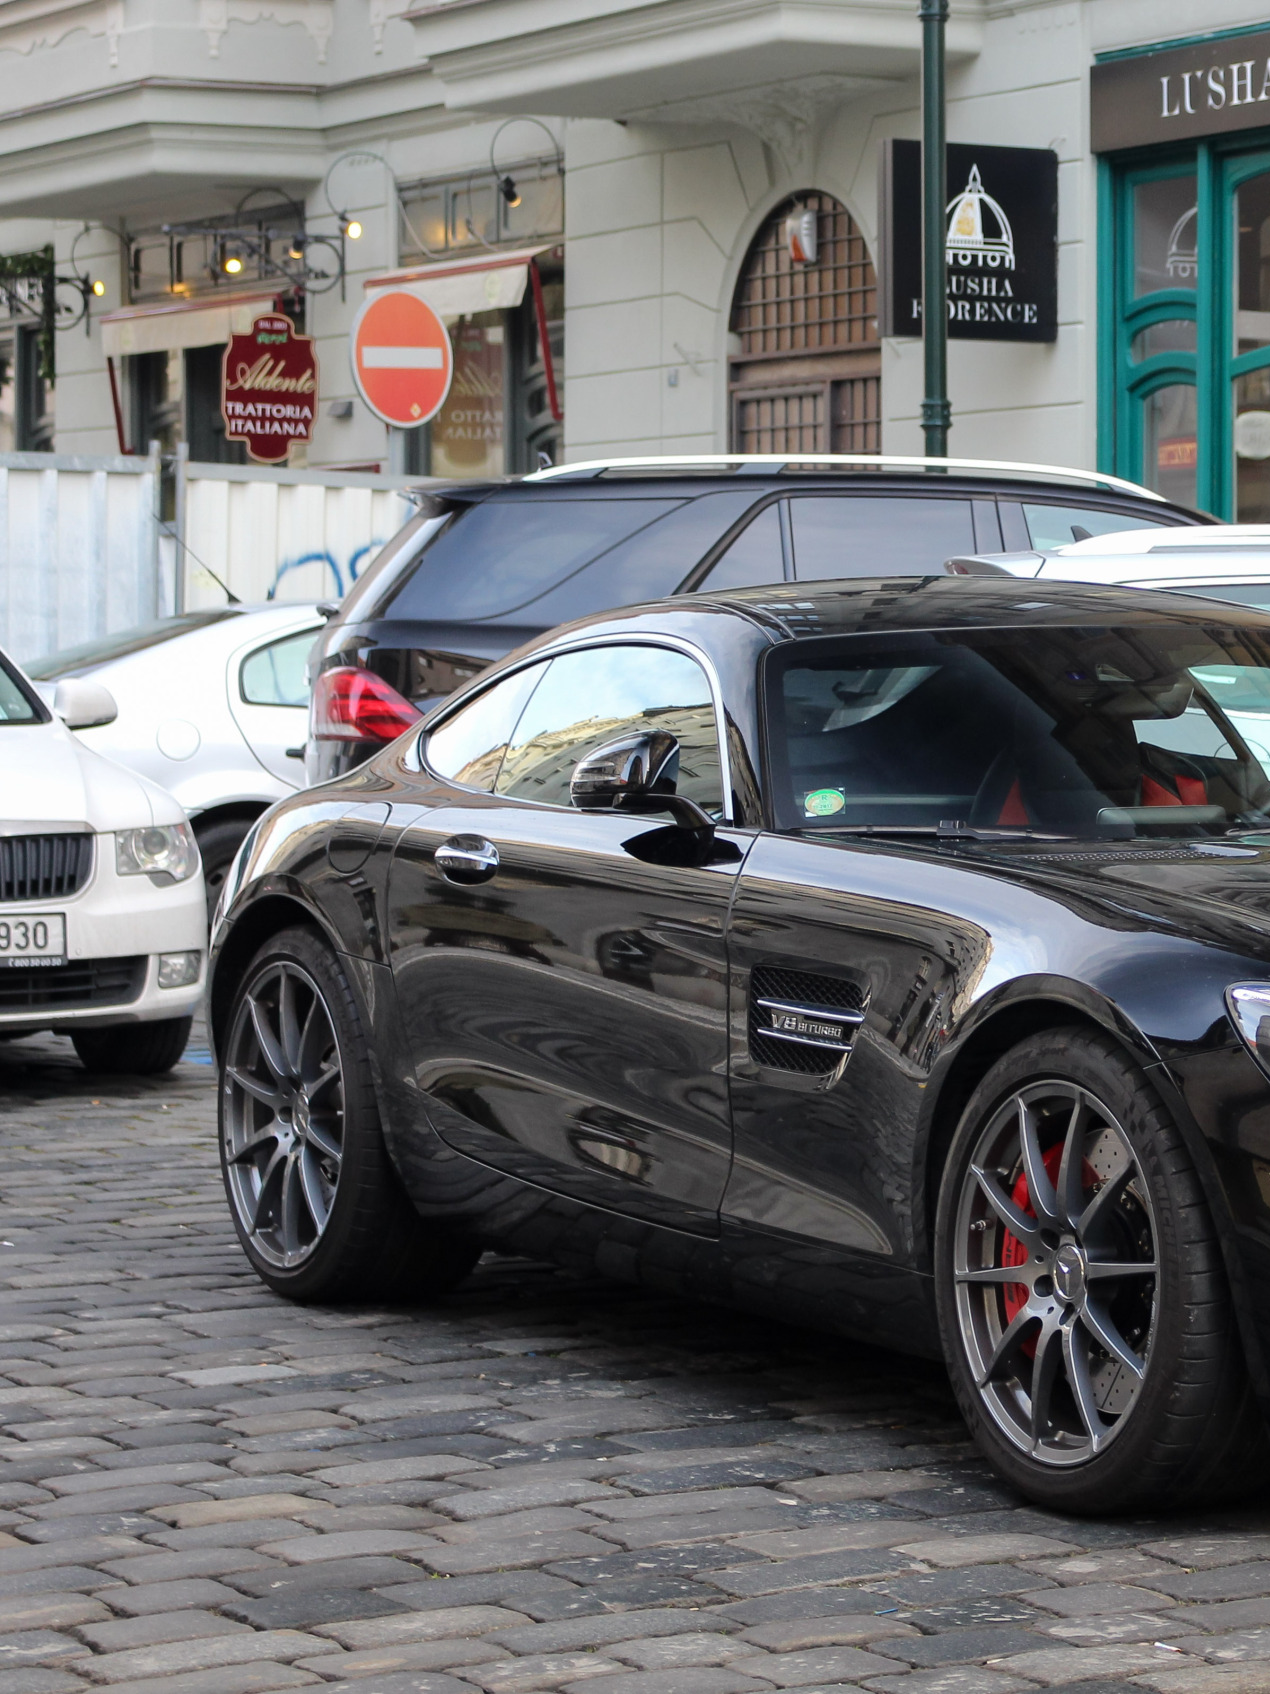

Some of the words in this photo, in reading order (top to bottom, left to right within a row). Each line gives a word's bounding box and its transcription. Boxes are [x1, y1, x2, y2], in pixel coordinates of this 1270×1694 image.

[945, 275, 1014, 297] USHA
[912, 299, 1038, 324] FORENCE
[226, 353, 317, 394] Aldente
[226, 402, 313, 420] TRATTORIA
[230, 418, 307, 437] ITALIANA
[0, 921, 48, 949] 930
[771, 1013, 796, 1030] V8
[798, 1022, 841, 1038] BITURBO
